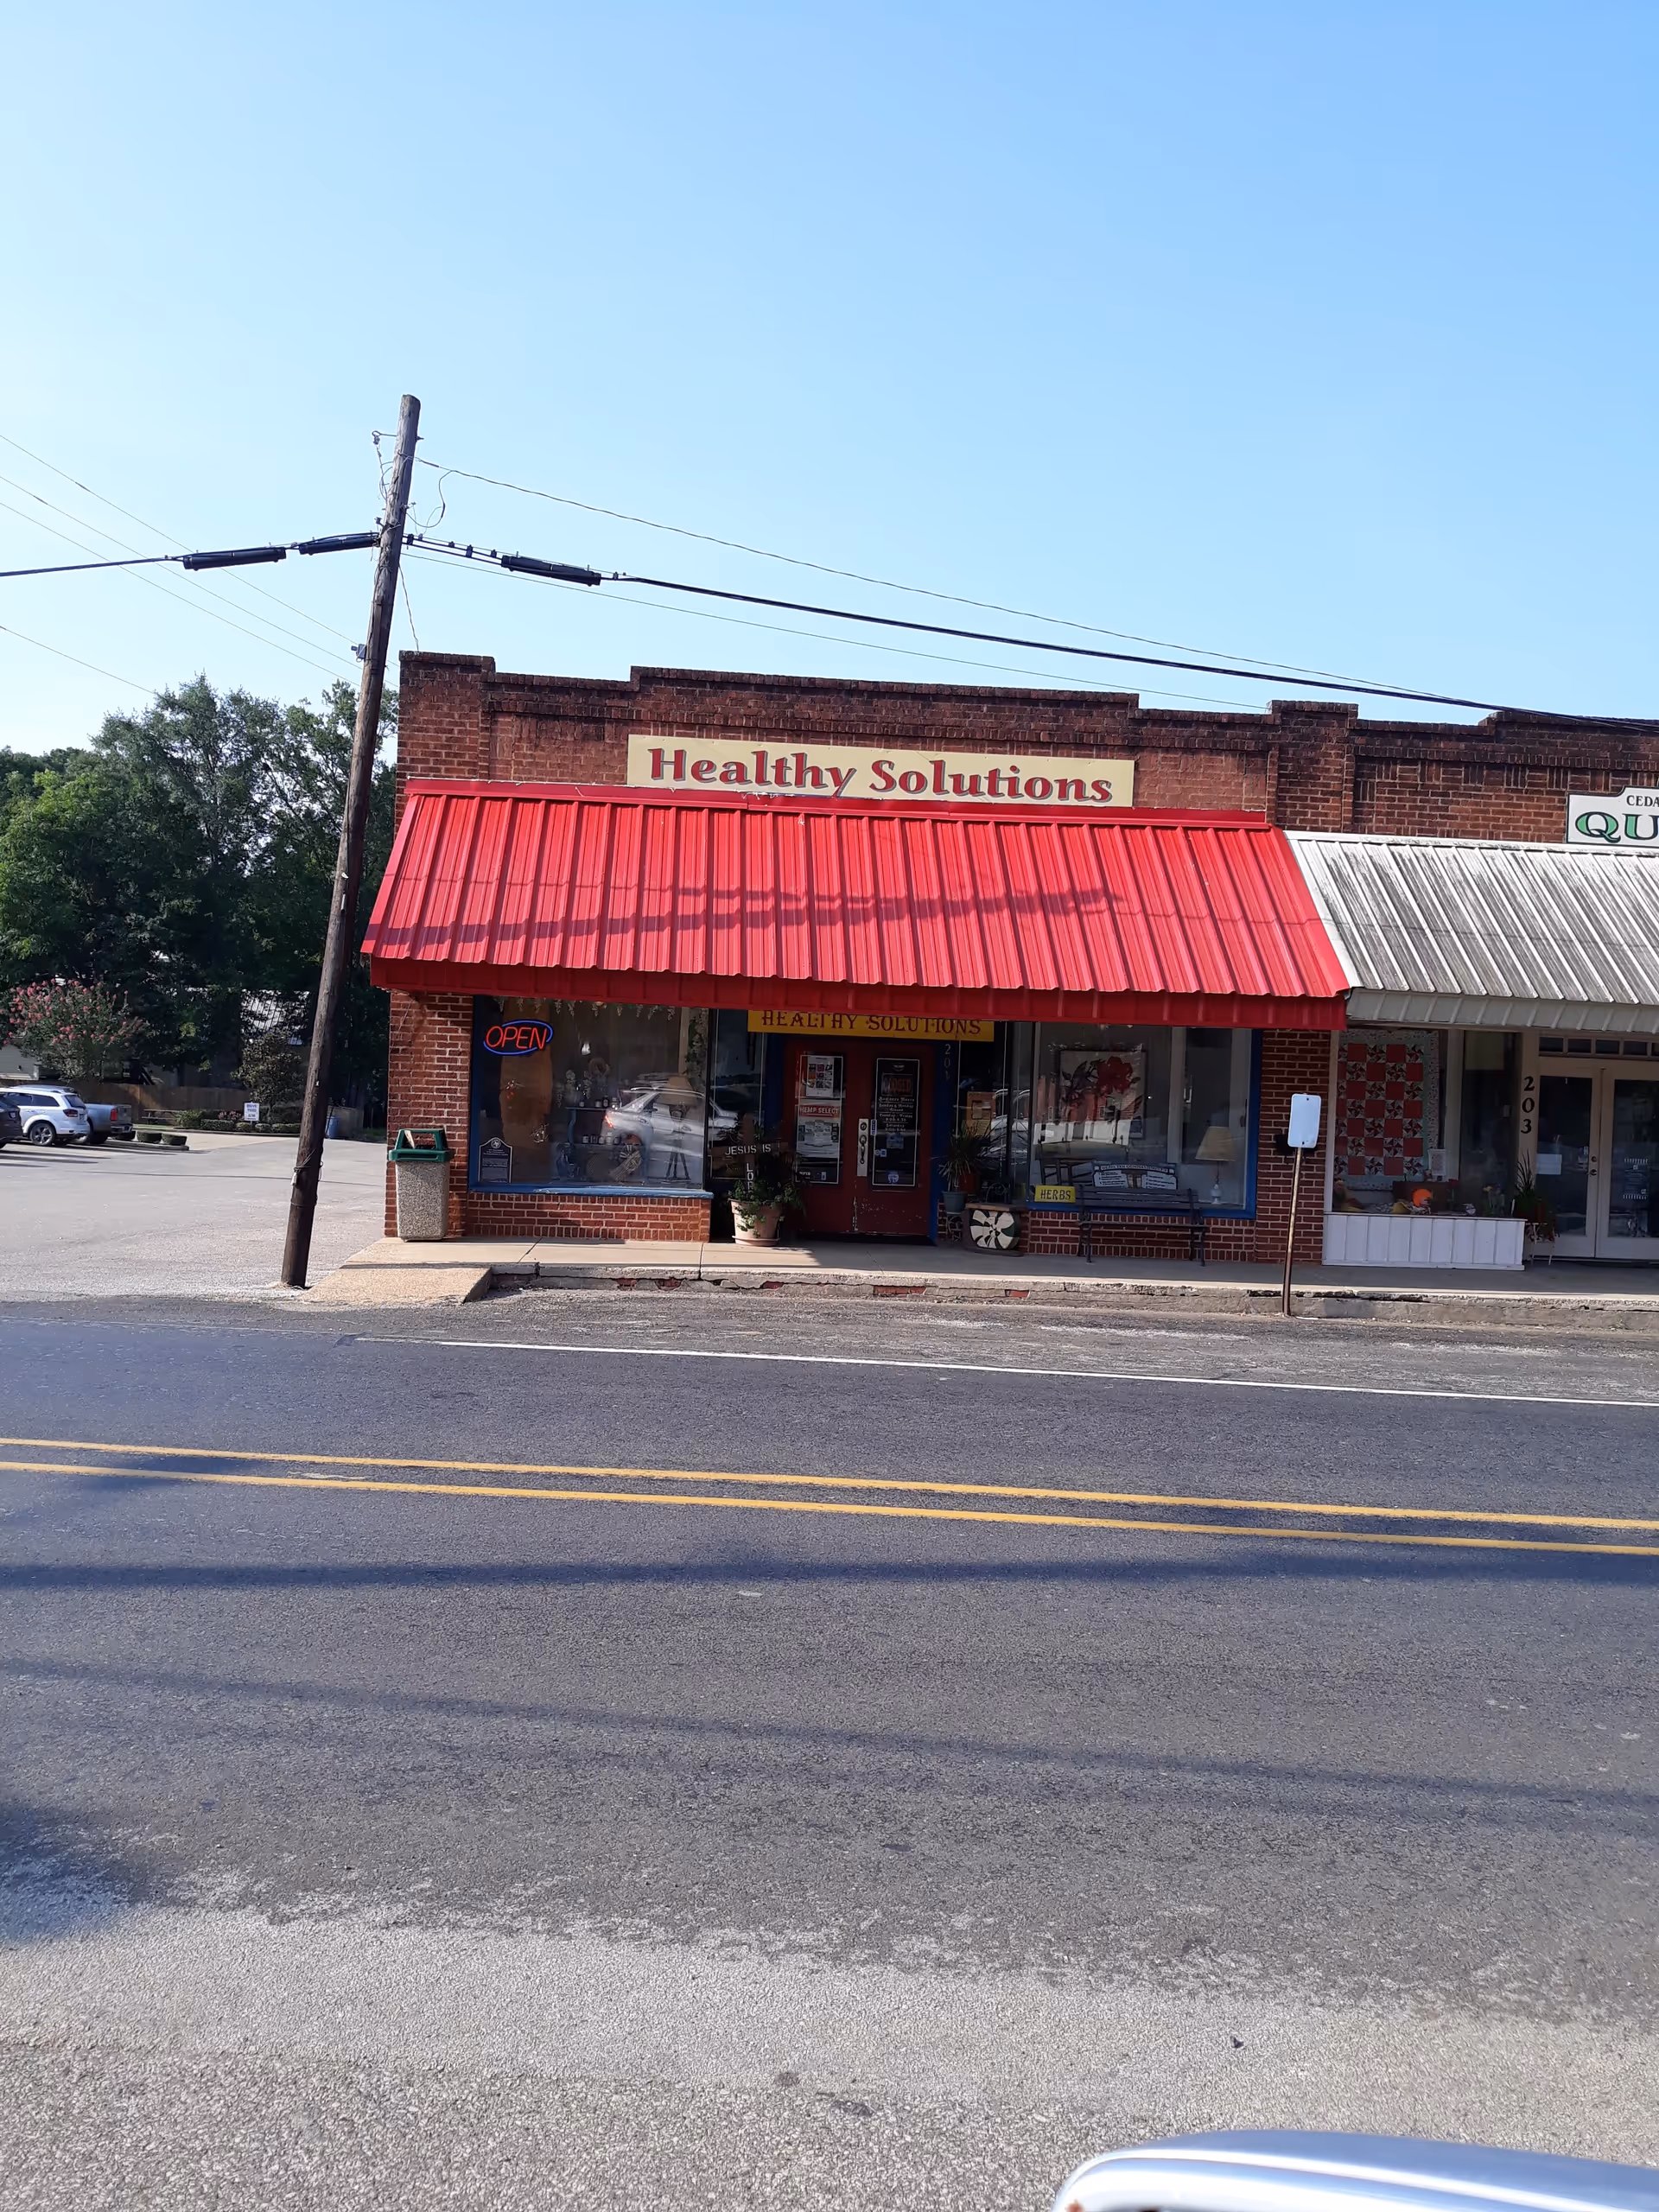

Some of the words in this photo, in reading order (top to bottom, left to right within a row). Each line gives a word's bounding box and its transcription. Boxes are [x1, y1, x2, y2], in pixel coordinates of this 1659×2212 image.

[648, 748, 857, 798] Healthy
[869, 760, 1113, 802] Solutions
[761, 1010, 858, 1029] HEALTHY
[868, 1015, 982, 1035] SOLUTIONS
[486, 1026, 547, 1050] OPEN
[1521, 1076, 1535, 1135] 203
[725, 1145, 757, 1155] JESUS
[762, 1144, 772, 1153] IS
[1040, 1189, 1071, 1200] HERBS
